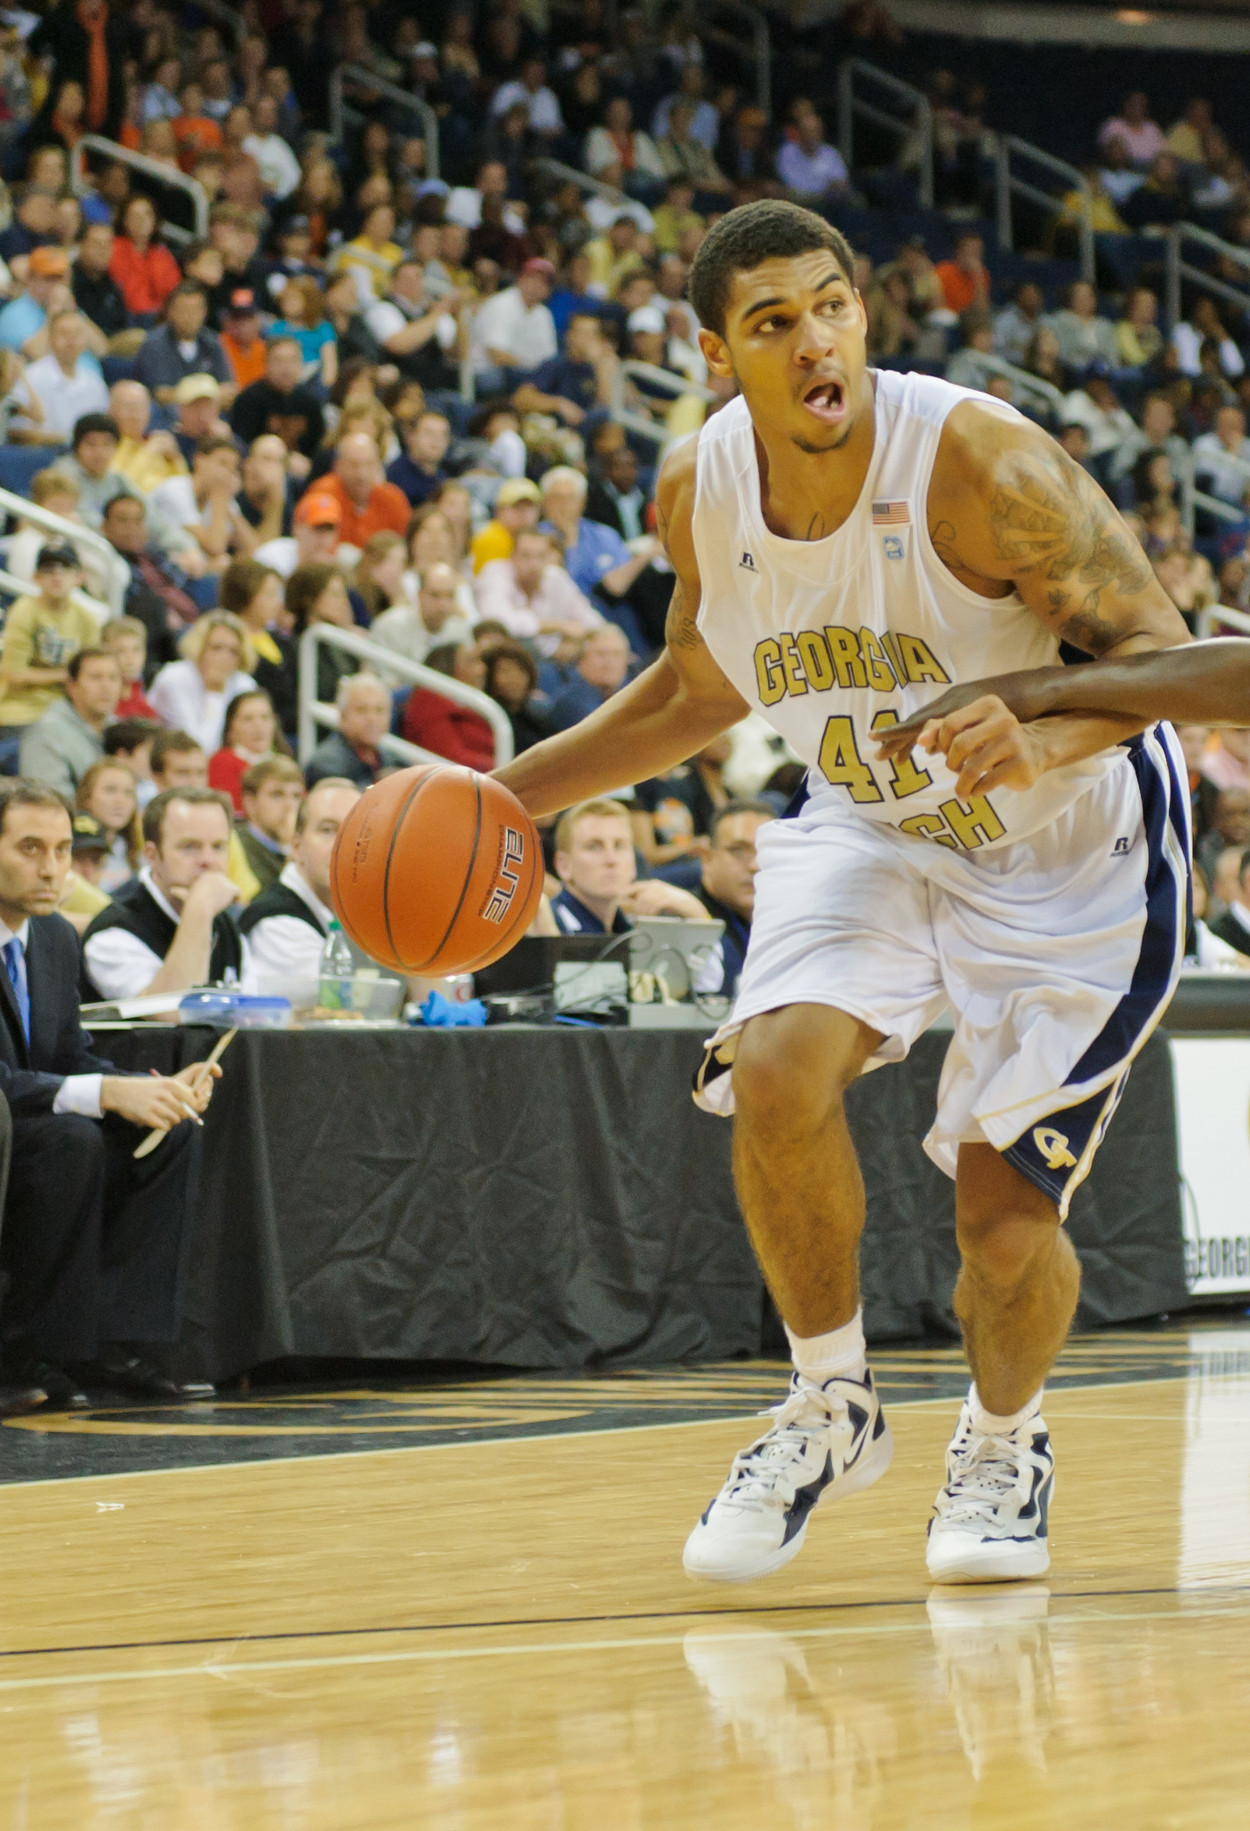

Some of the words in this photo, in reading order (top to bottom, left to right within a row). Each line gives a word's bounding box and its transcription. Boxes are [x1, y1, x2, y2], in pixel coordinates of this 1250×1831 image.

[754, 626, 951, 707] GEORGIA
[818, 709, 933, 804] 41
[897, 796, 1007, 850] CH
[482, 826, 524, 925] ELITE
